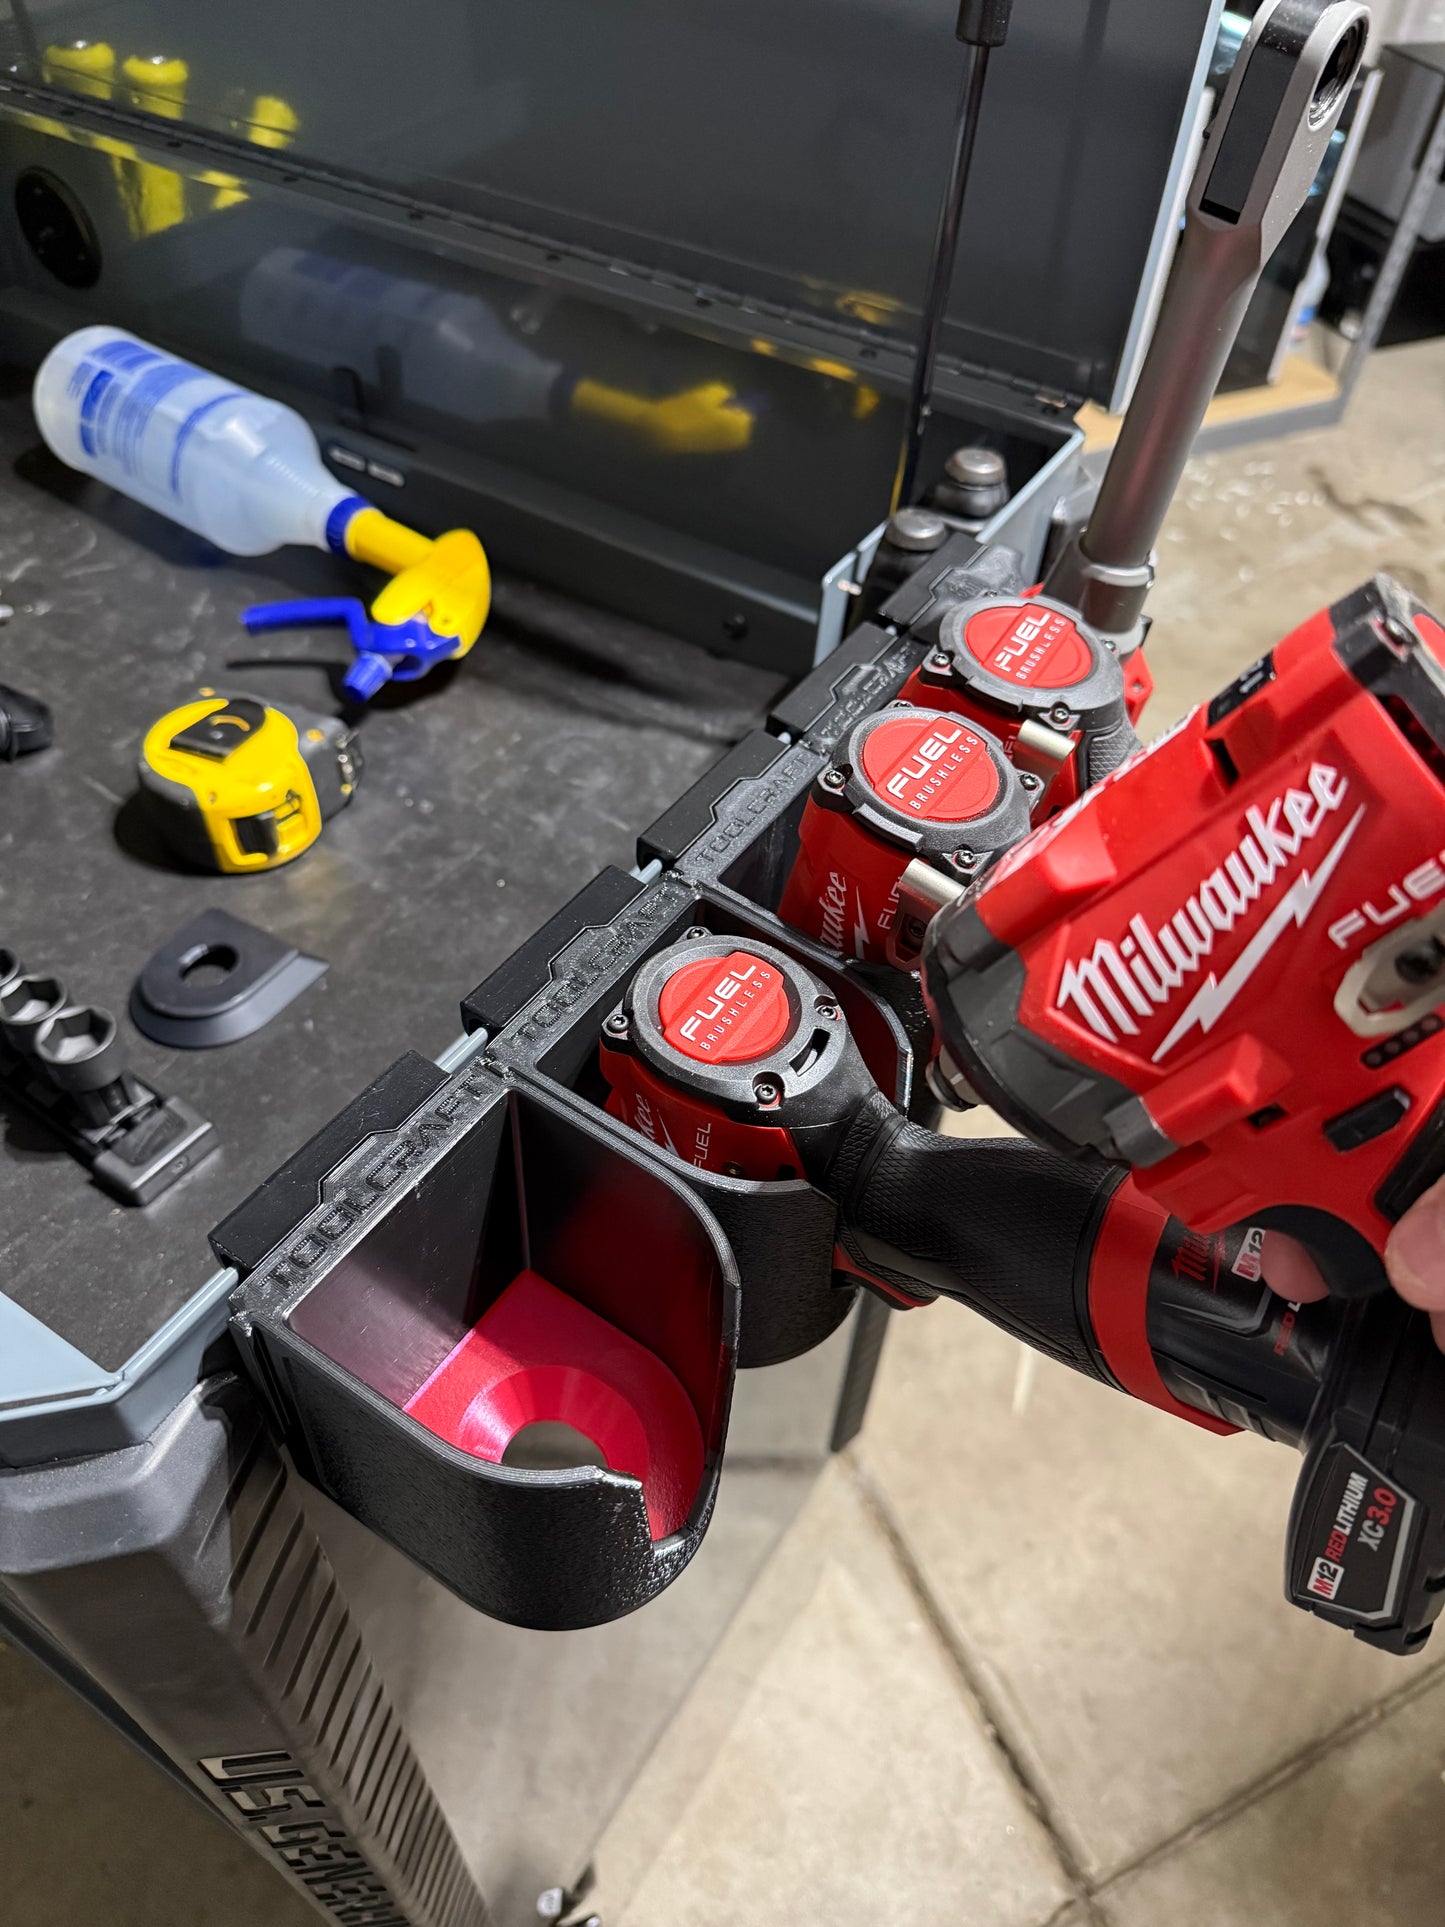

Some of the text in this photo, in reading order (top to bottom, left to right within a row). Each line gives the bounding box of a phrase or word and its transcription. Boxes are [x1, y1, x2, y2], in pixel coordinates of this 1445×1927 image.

[994, 612, 1052, 672] FUEL
[1015, 616, 1067, 680] BRUSHLESS
[694, 753, 810, 863] TOOLCRAFT
[886, 729, 963, 800] FUEL
[909, 736, 979, 810] BRUSHLESS
[1056, 762, 1350, 1045] Milwaukee
[1328, 849, 1445, 950] FUE
[509, 884, 678, 1043] TOOLCRAFT
[679, 965, 757, 1042] FUEL
[700, 971, 771, 1051] BRUSHLESS
[257, 1073, 484, 1297] TOOLCRAFT
[1313, 1471, 1369, 1596] M12 REDLITHIUM
